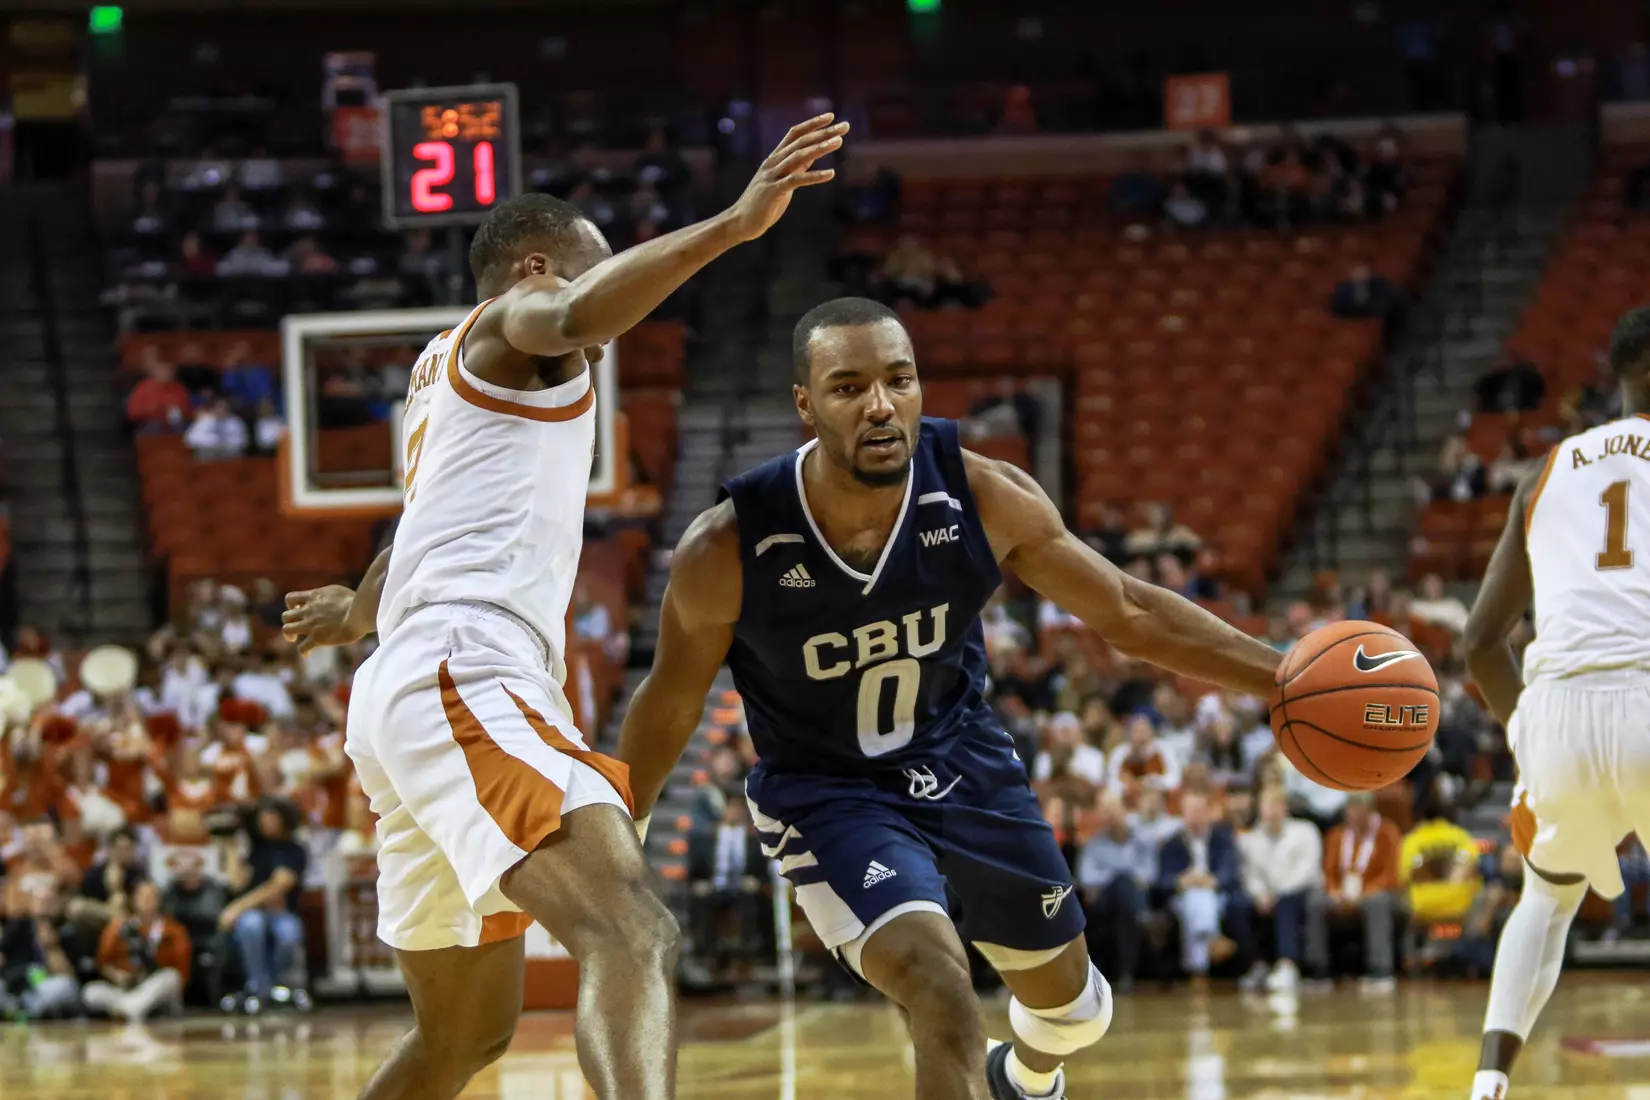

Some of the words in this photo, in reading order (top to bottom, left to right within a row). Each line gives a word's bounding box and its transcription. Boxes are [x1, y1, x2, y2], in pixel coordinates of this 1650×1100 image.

[411, 141, 496, 213] 21
[1572, 447, 1593, 469] A.
[919, 524, 960, 548] WAC
[1595, 479, 1634, 571] 1
[779, 577, 816, 588] adidas
[803, 602, 949, 681] CBU
[857, 658, 921, 758] 0
[1363, 703, 1429, 726] ELITE
[863, 869, 897, 889] adidas
